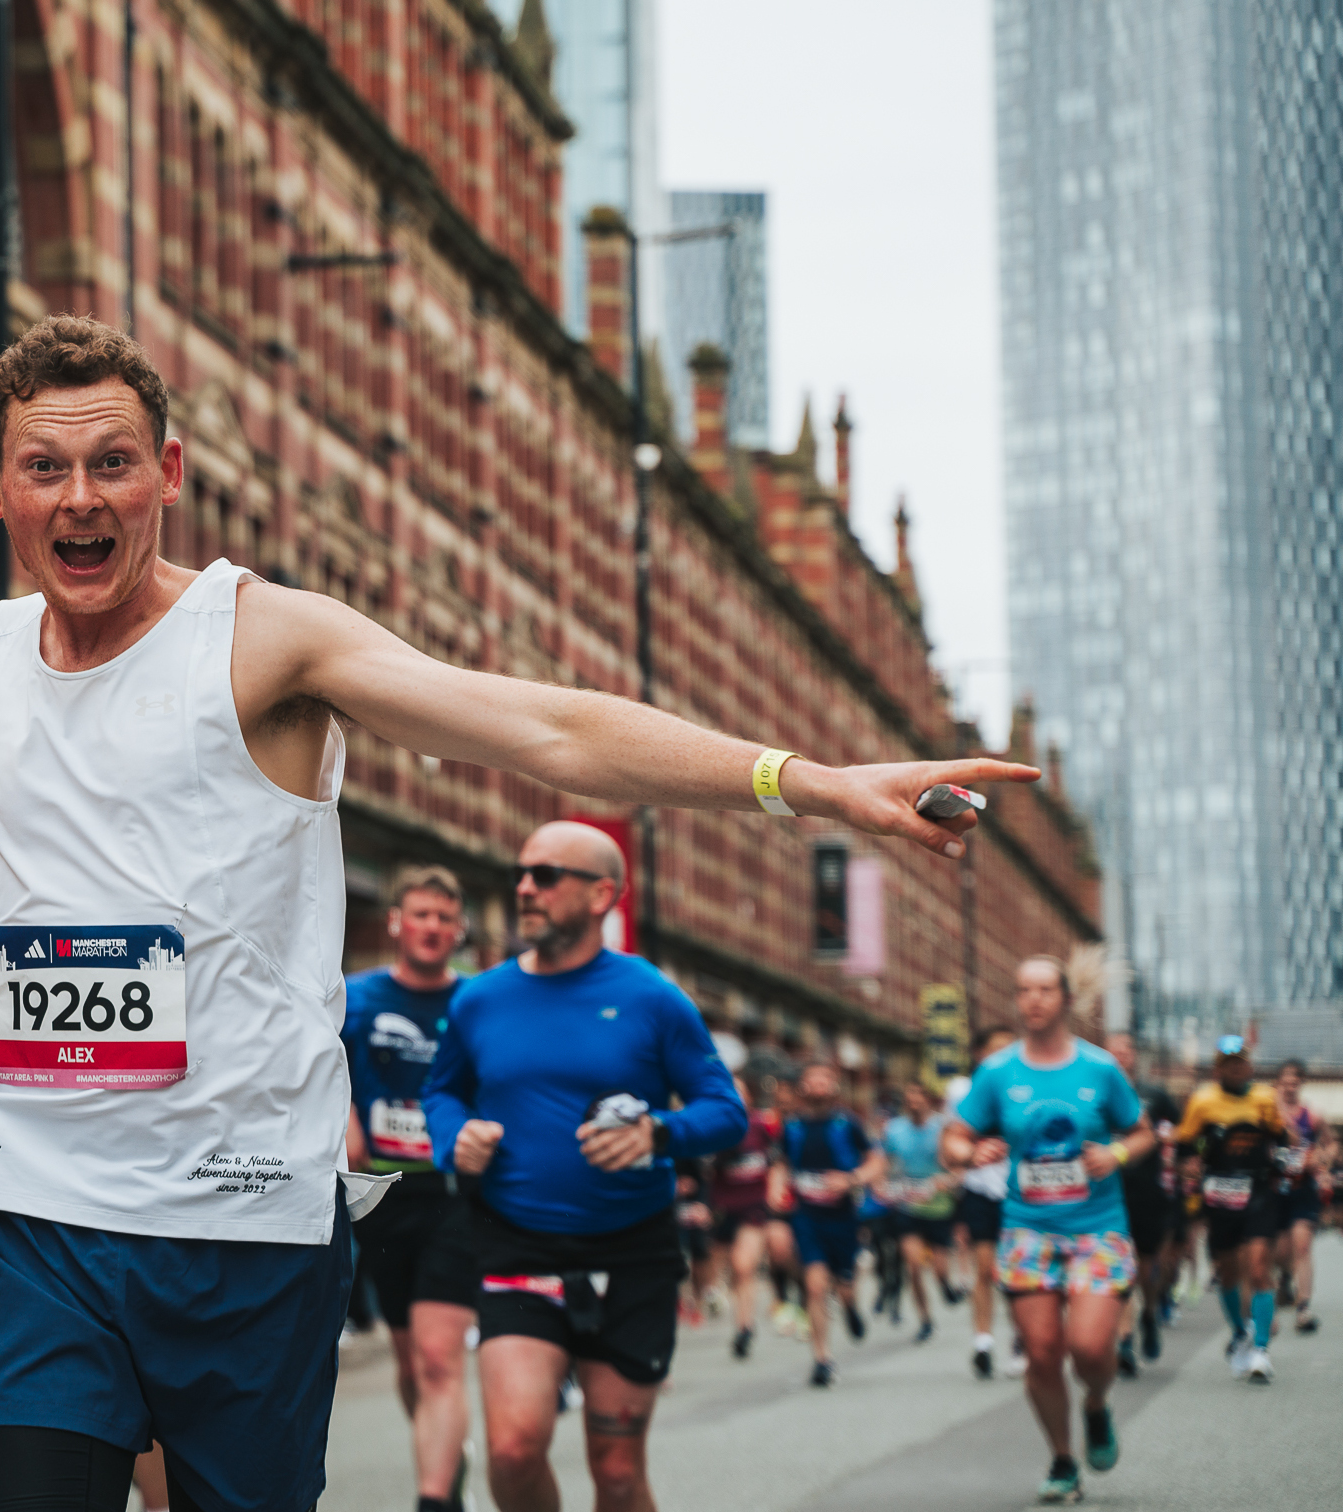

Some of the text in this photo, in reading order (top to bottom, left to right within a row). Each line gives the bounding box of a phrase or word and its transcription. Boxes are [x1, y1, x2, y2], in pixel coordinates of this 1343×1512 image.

[72, 938, 127, 947] MANCHESTER
[72, 946, 128, 957] MARATHON
[8, 981, 154, 1032] 19268
[57, 1046, 95, 1064] ALEX
[14, 1072, 33, 1082] AREA:
[34, 1073, 49, 1082] PINK
[49, 1073, 55, 1083] B
[76, 1072, 179, 1083] #MANCHESTERMARATHON
[203, 1153, 284, 1168] Alex & Natalie
[187, 1167, 293, 1182] Adventuring together
[216, 1183, 266, 1195] since 2022
